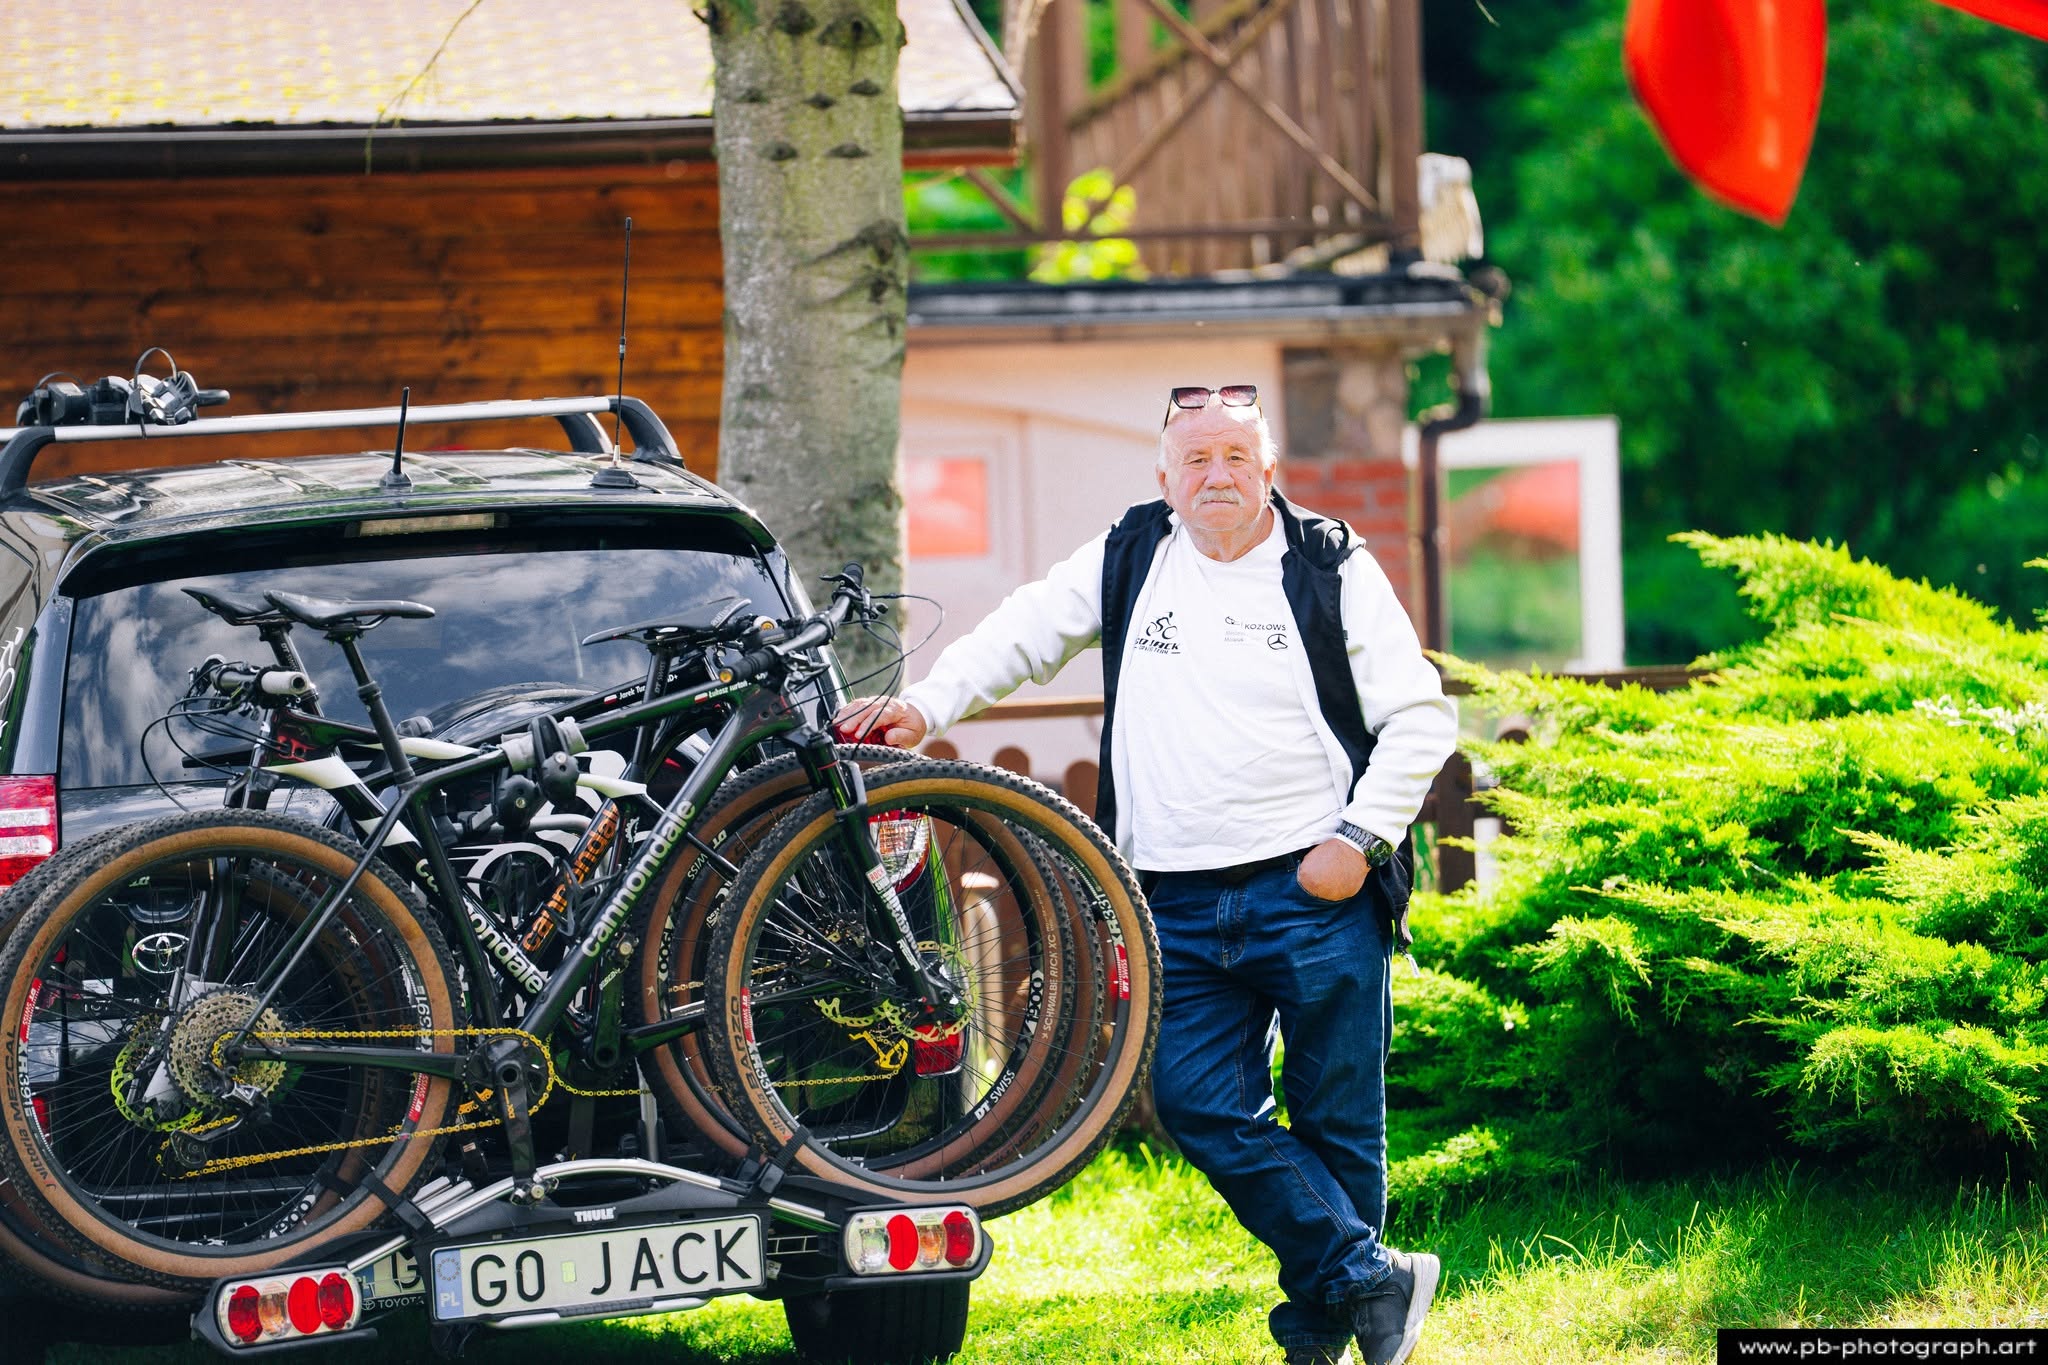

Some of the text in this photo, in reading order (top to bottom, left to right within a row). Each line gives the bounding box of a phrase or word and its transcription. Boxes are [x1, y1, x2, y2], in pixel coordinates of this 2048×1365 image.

[582, 800, 696, 957] cannondale
[686, 852, 708, 881] WISS
[1026, 977, 1044, 1023] 1900
[1043, 979, 1059, 1032] SCHWALBE
[730, 996, 759, 1090] BARZO
[5, 1025, 23, 1122] MEZCAL
[974, 1069, 1016, 1120] DT SWISS
[574, 1207, 616, 1223] THULE
[470, 1226, 751, 1308] GO JACK
[440, 1291, 460, 1308] PL
